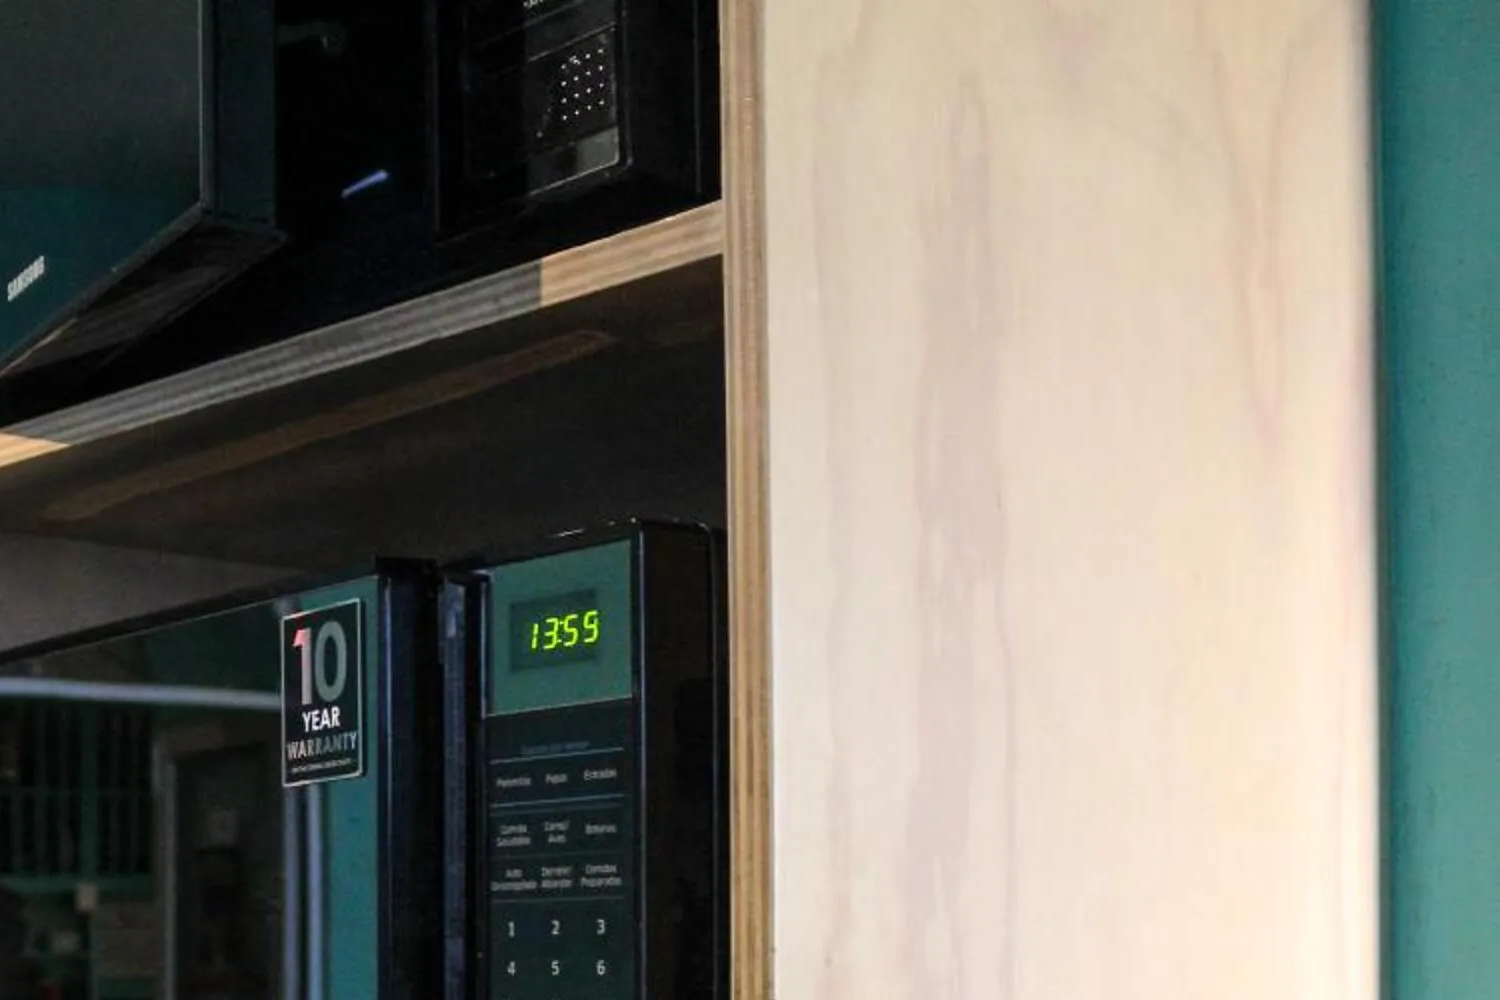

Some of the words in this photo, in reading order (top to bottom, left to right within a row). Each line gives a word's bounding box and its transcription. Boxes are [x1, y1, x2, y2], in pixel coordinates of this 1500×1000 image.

[531, 609, 599, 650] 13:59
[292, 620, 348, 705] 10
[302, 705, 341, 732] YEAR
[286, 732, 358, 759] WARRANTY
[508, 921, 516, 938] 1
[551, 919, 560, 935] 2
[596, 918, 606, 935] 3
[506, 960, 516, 977] 4
[551, 960, 560, 976] 5
[596, 959, 606, 976] 6
